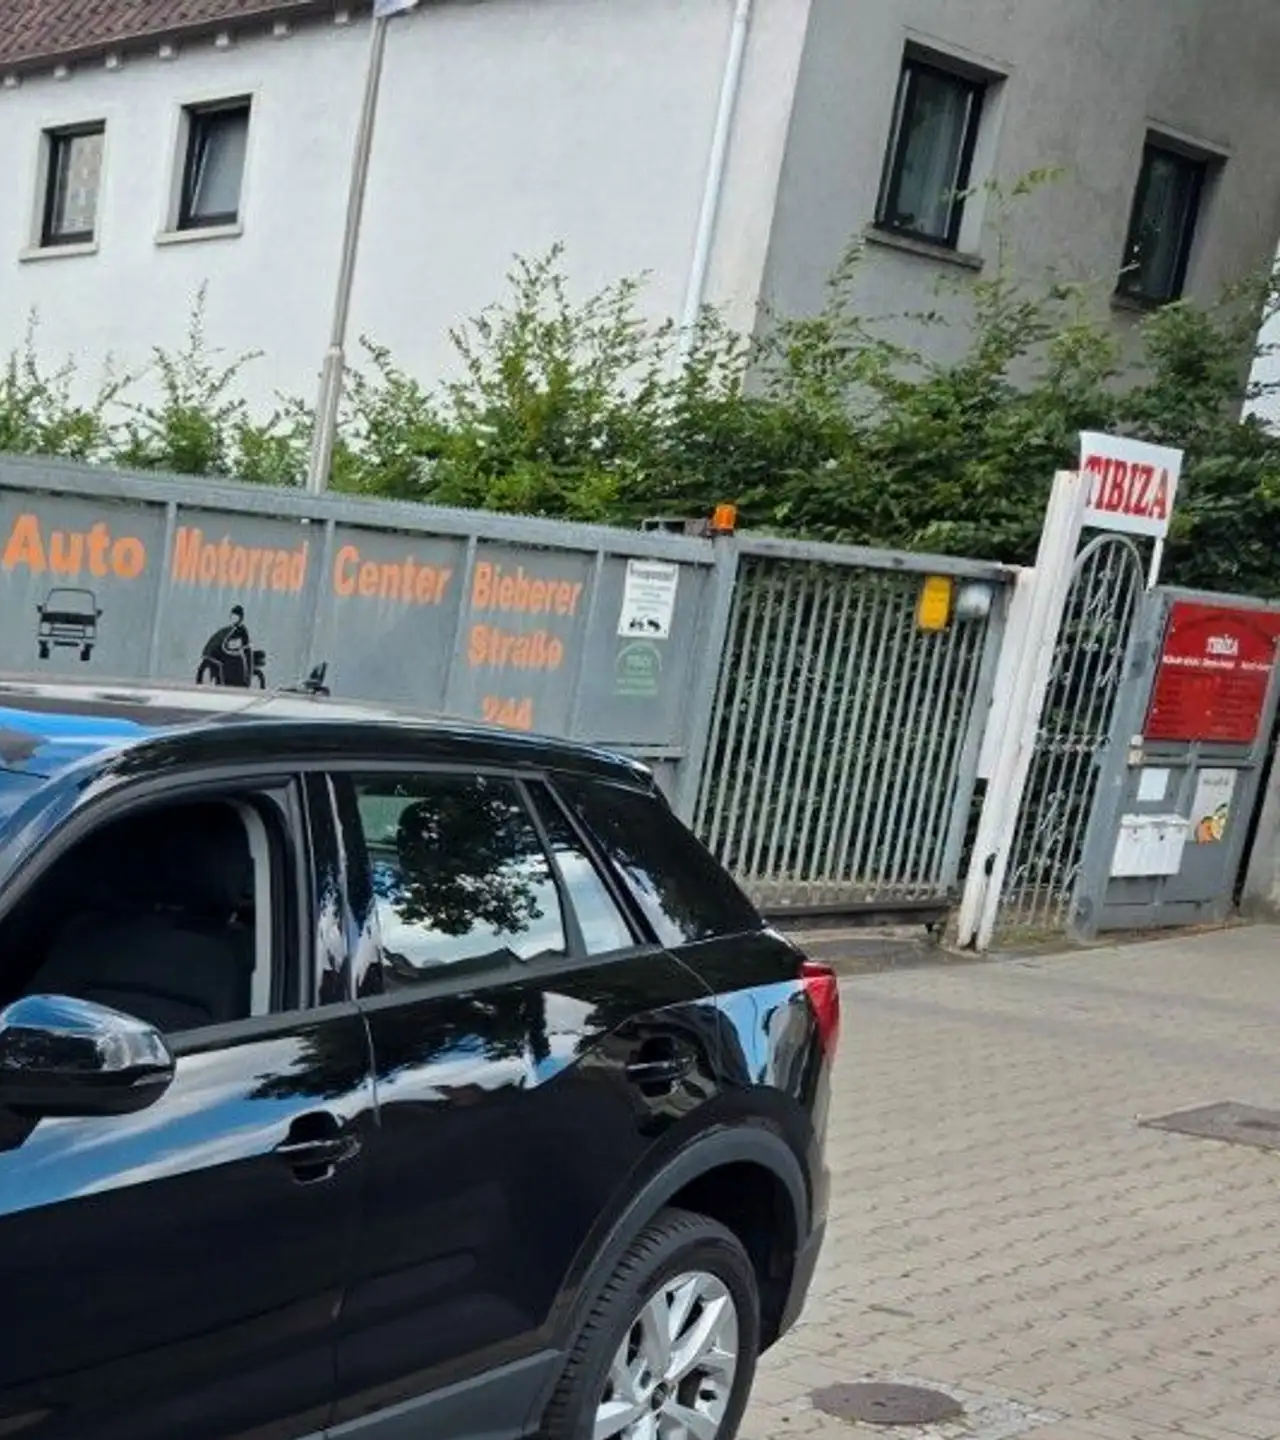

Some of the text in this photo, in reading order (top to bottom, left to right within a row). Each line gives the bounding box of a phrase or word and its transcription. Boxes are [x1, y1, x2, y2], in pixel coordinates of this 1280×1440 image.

[1084, 454, 1169, 520] TIBIZA
[0, 512, 146, 579] Auto
[172, 525, 310, 592] Motorrad
[333, 544, 454, 606] Center
[471, 560, 583, 616] Bieberer
